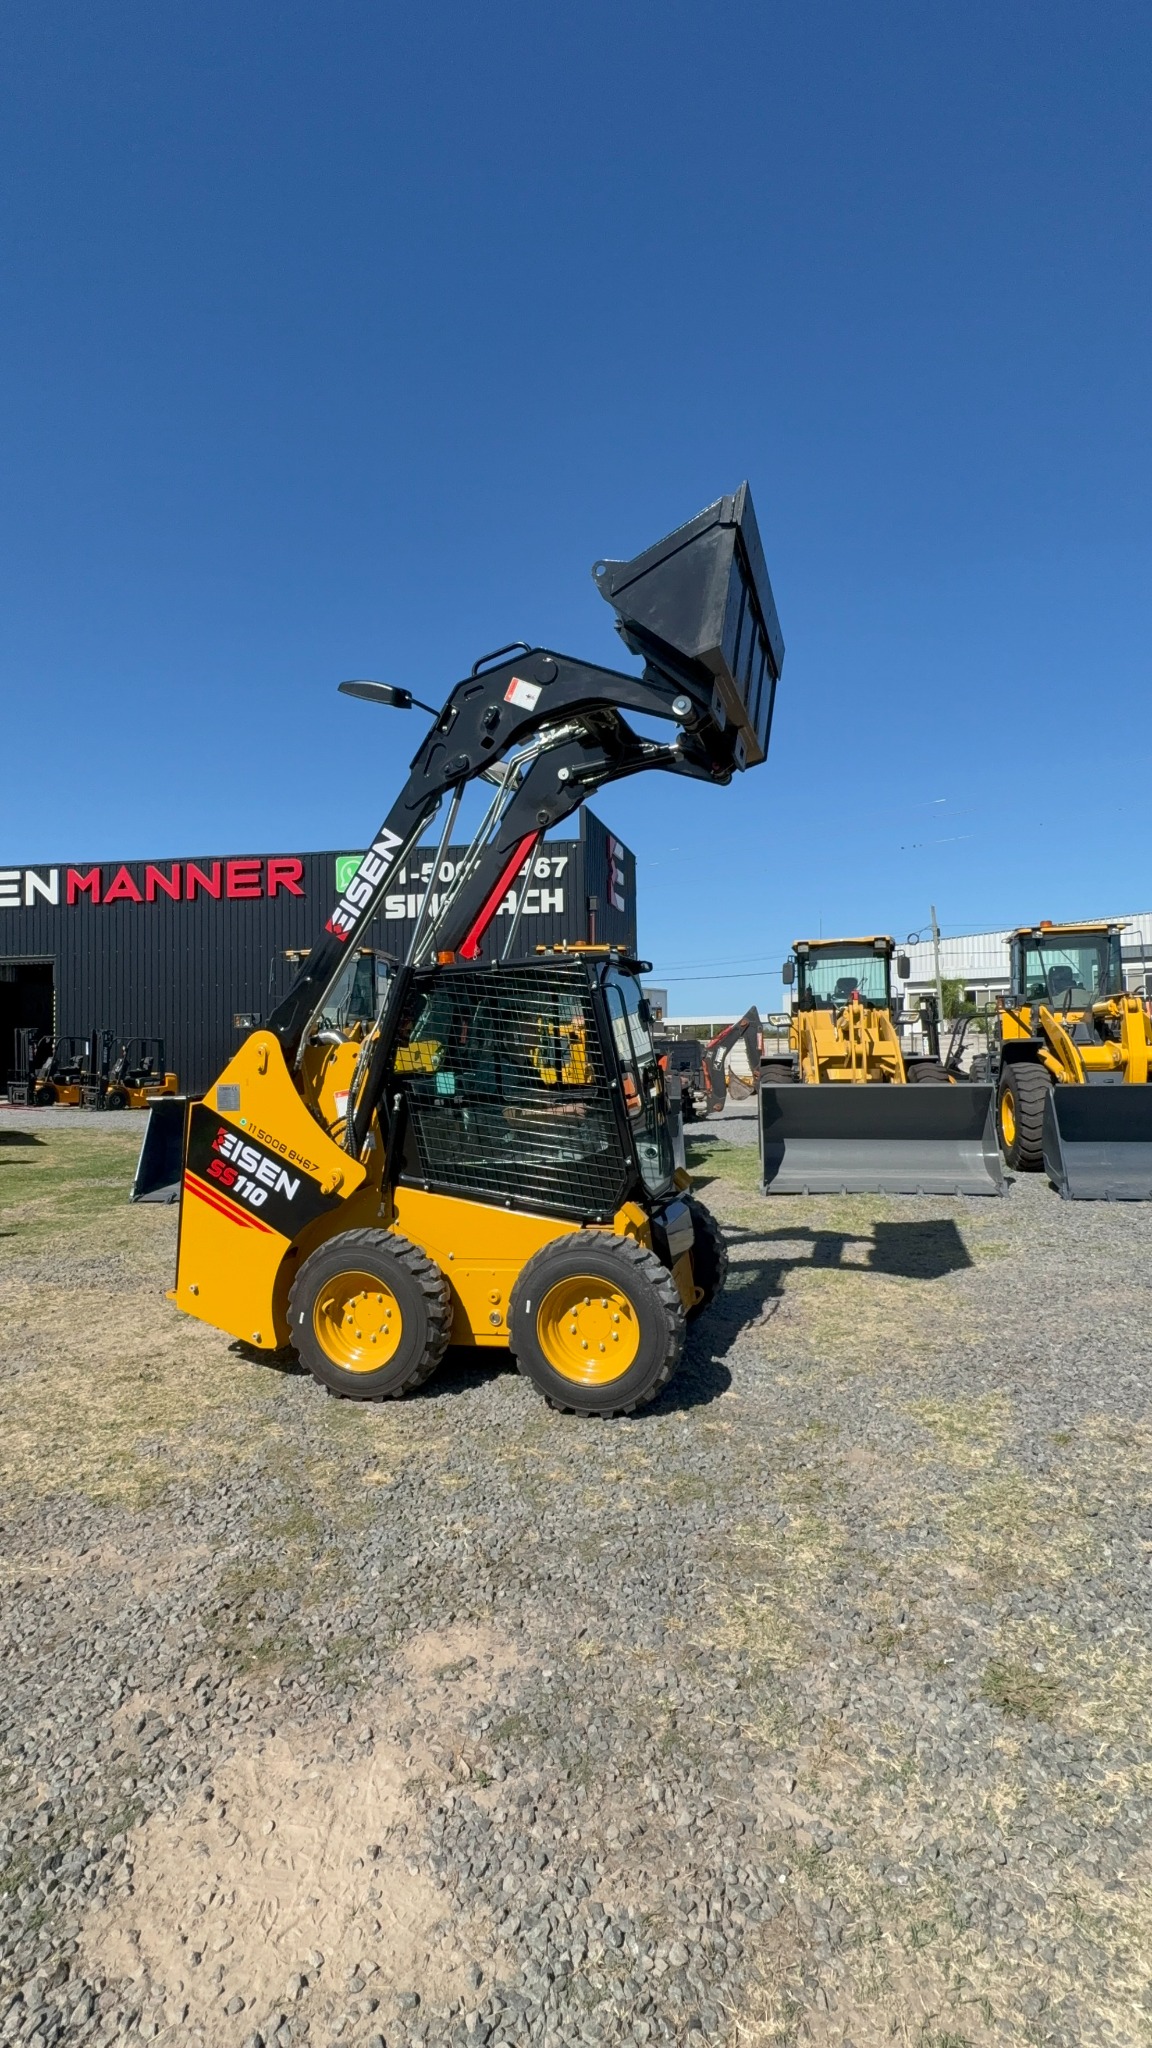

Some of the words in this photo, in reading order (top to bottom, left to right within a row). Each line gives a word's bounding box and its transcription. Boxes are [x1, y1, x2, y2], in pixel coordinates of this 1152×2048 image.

[325, 828, 404, 942] EISEN
[211, 1127, 301, 1201] EISEN
[248, 1123, 257, 1134] 11
[257, 1129, 287, 1153] 5008
[288, 1150, 320, 1172] 8467
[206, 1158, 268, 1207] SS110
